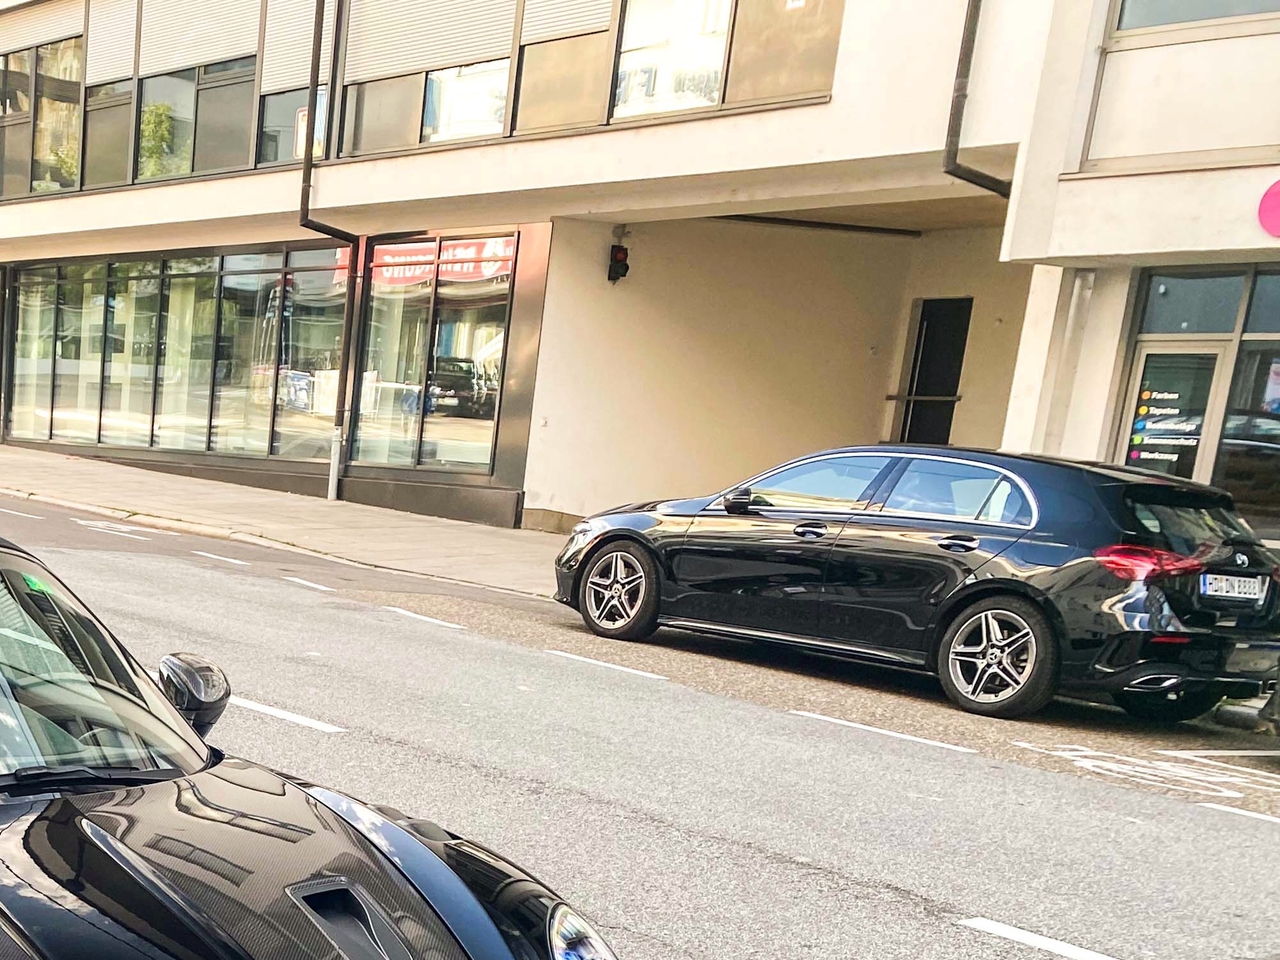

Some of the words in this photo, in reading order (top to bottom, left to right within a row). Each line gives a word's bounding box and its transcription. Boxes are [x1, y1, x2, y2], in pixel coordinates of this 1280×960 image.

[1151, 391, 1179, 400] Farben
[1148, 406, 1180, 415] Tapeten
[1140, 451, 1179, 462] Werkzeug
